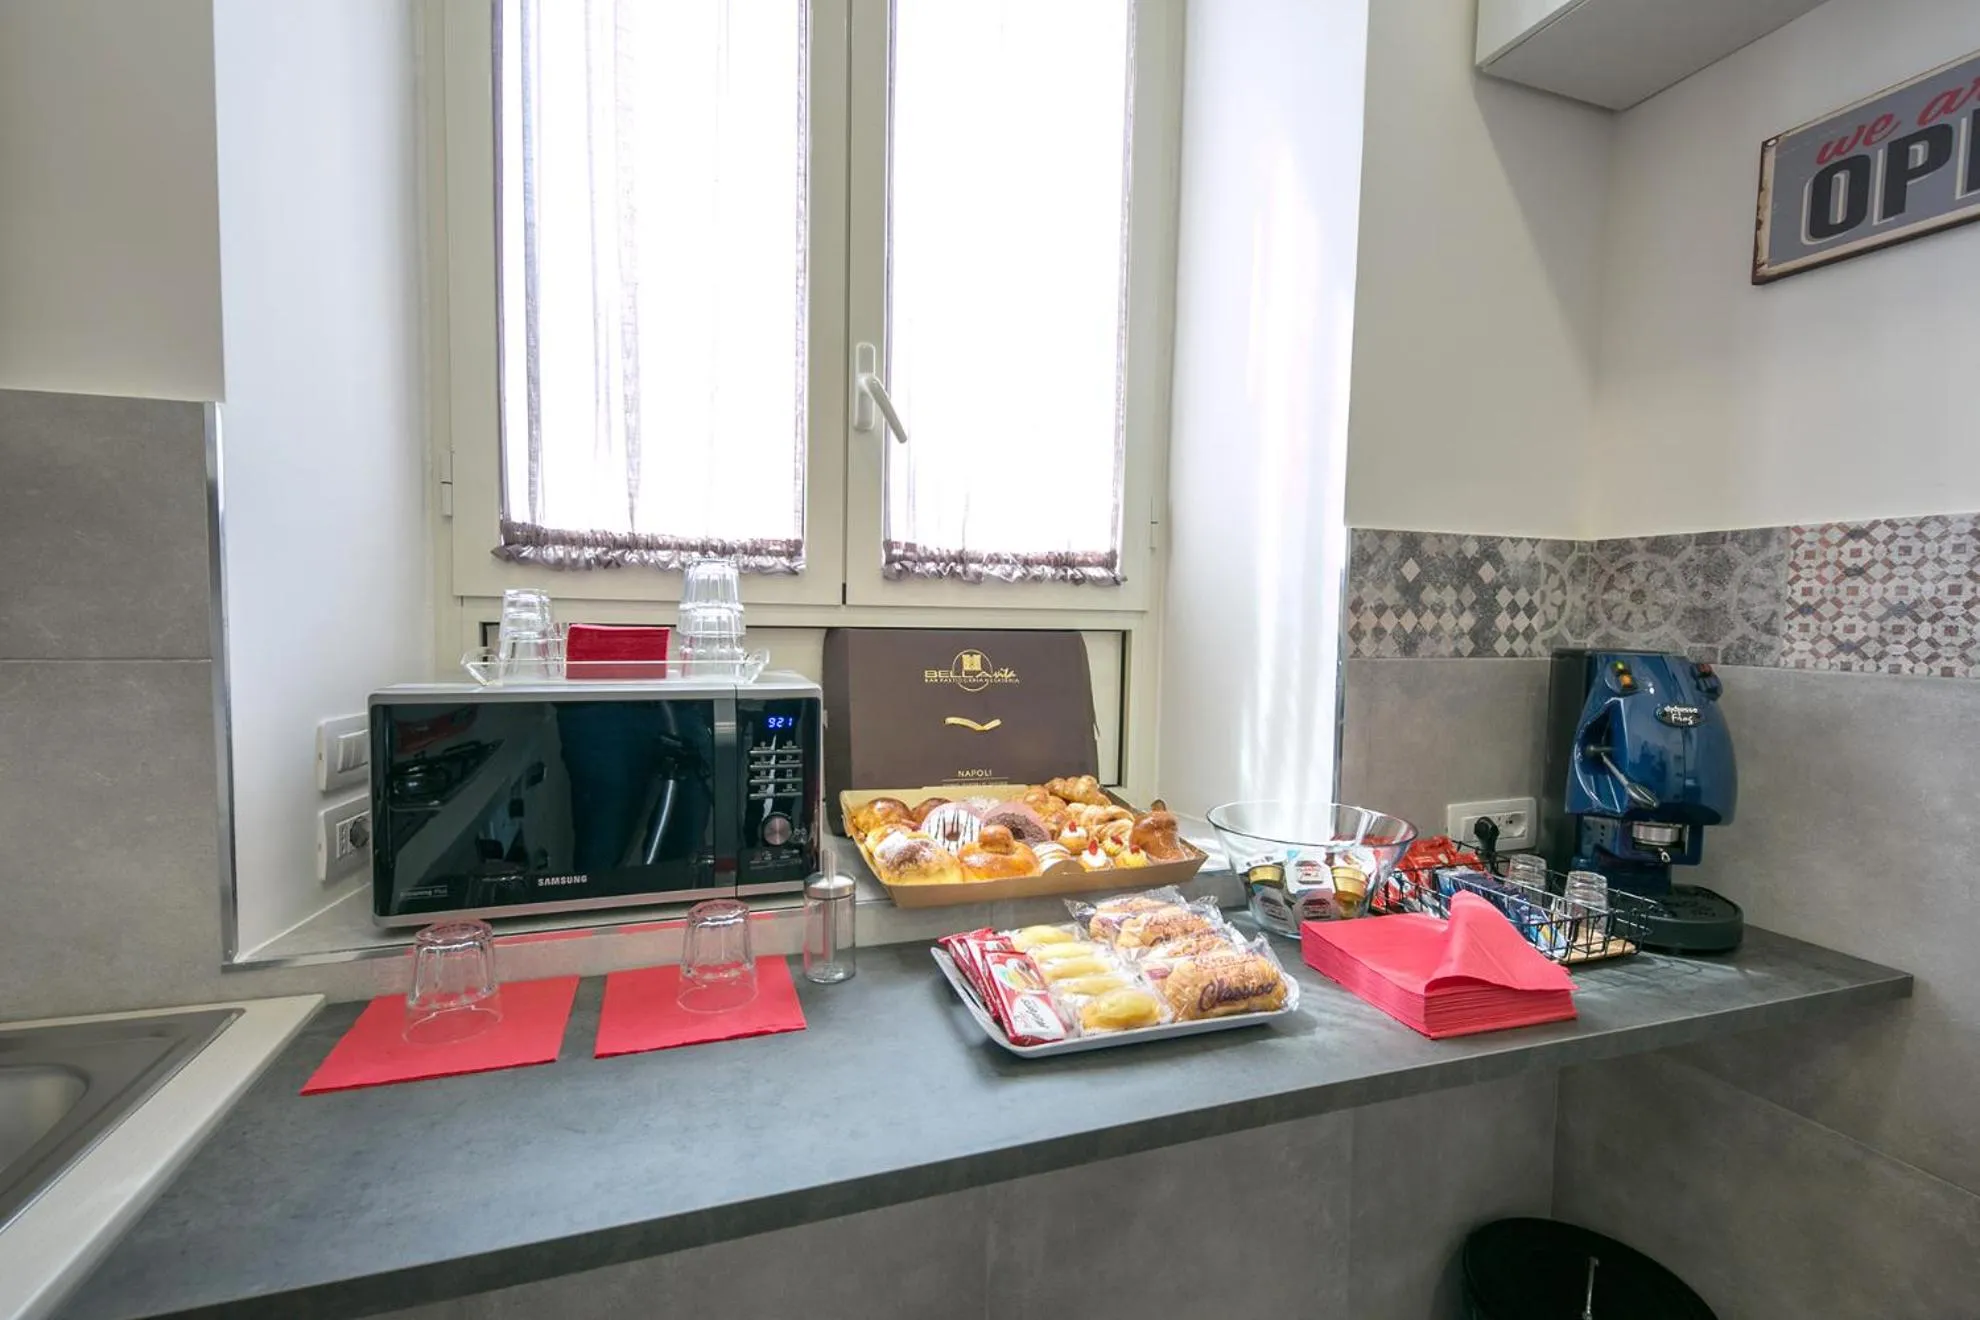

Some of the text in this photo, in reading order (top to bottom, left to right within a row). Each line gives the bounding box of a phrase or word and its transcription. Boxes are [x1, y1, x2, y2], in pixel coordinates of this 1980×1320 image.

[1815, 112, 1902, 166] we
[1801, 108, 1980, 246] OP
[957, 768, 992, 777] NAPOLI
[537, 874, 588, 887] SAMSUNG
